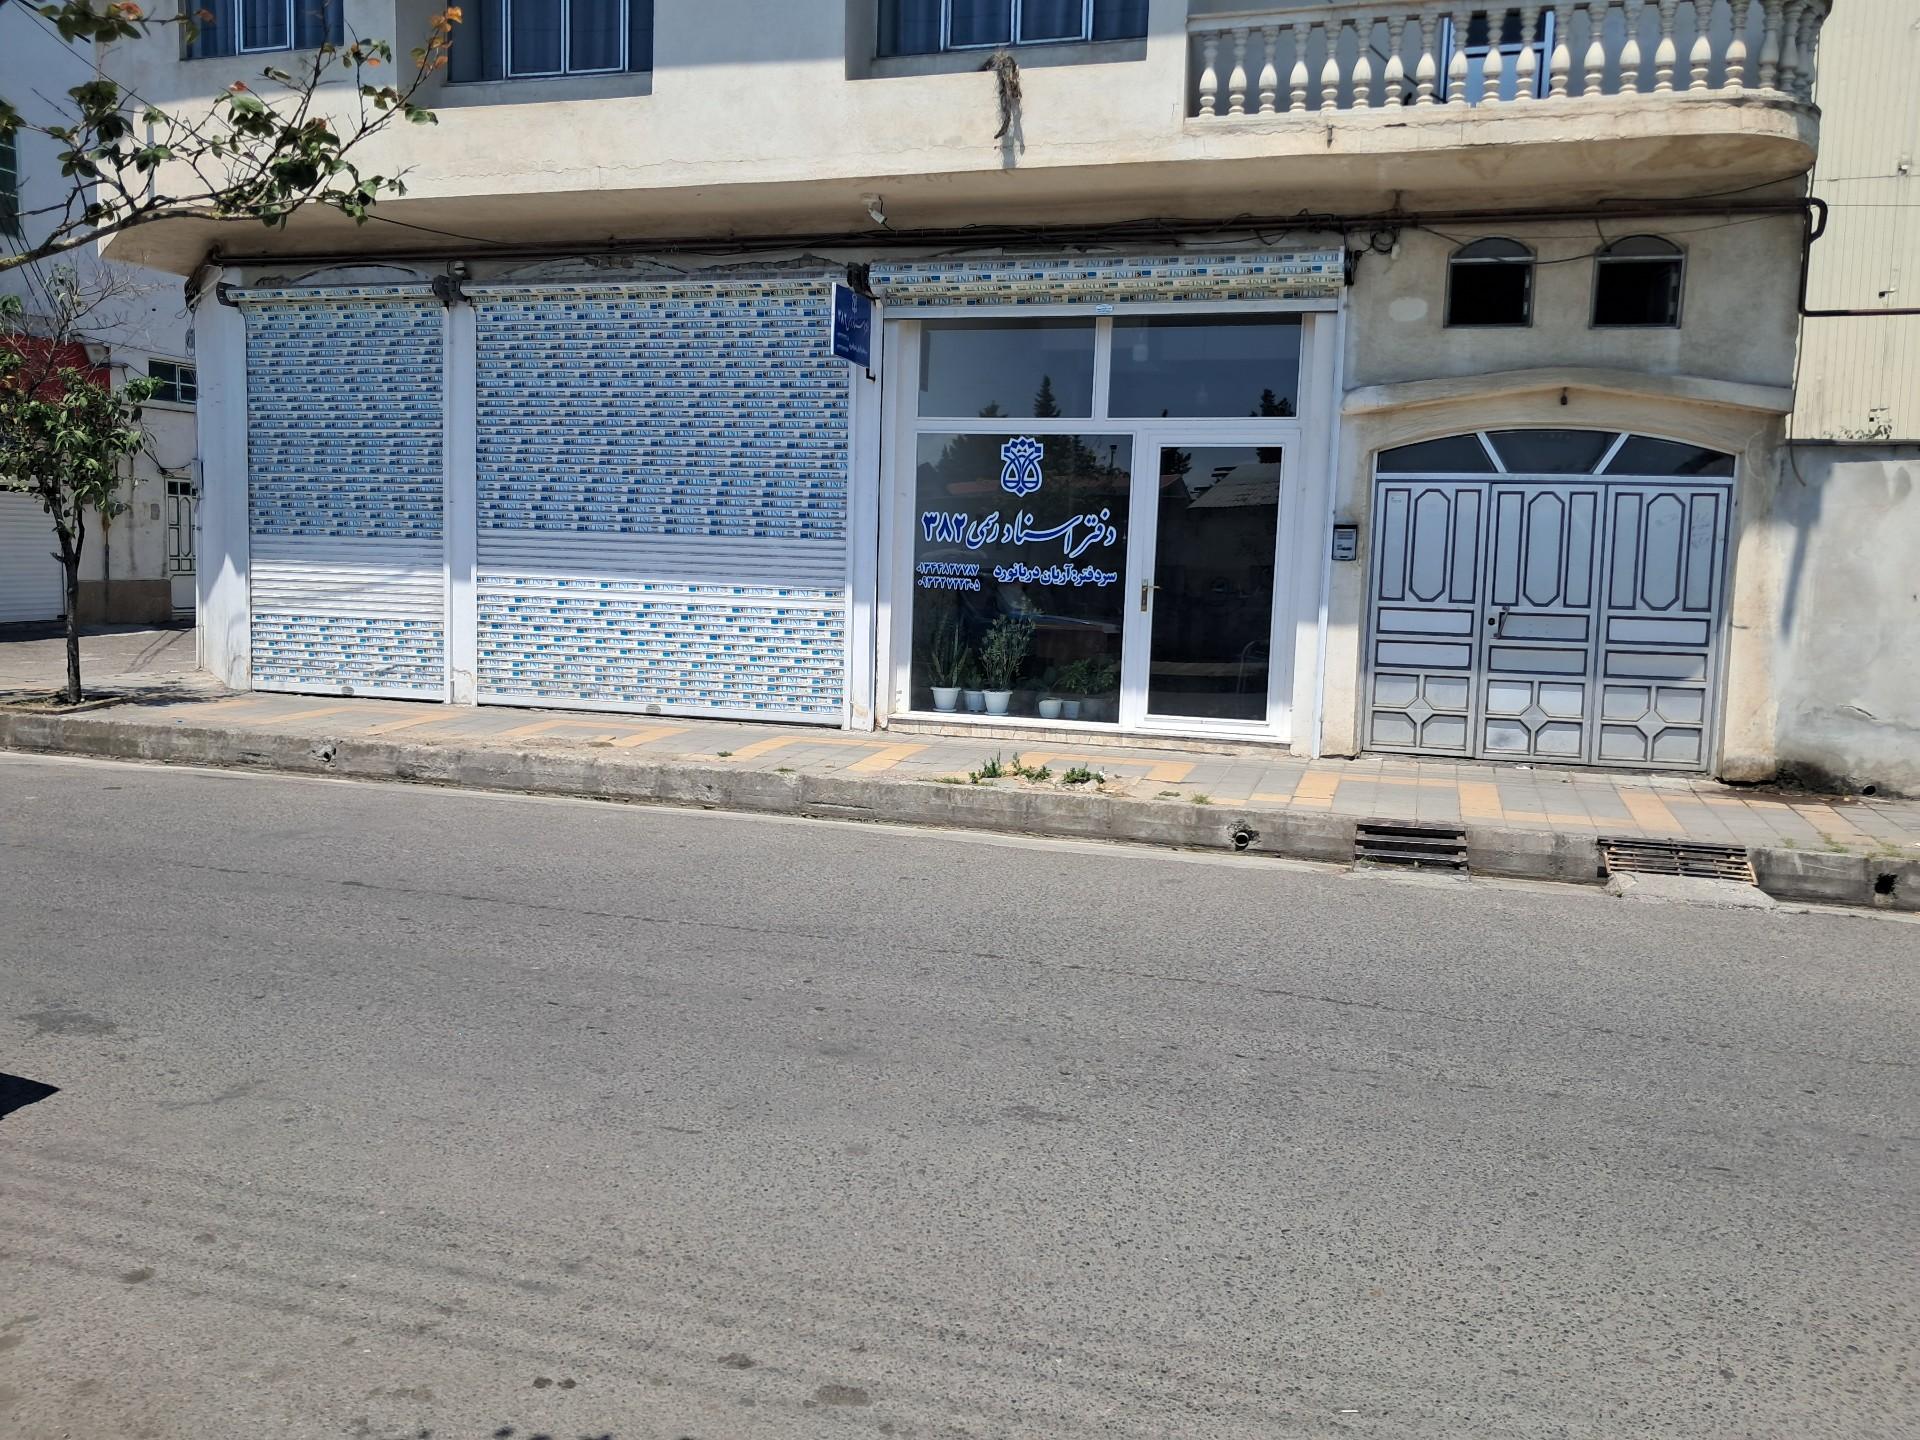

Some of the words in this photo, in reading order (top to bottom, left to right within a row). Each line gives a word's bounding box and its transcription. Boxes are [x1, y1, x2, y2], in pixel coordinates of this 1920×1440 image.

[921, 511, 967, 543] ۳۸۲
[965, 511, 999, 549] رسمی
[1001, 508, 1083, 554] اسناد
[1069, 508, 1117, 558] دفتر
[993, 562, 1041, 584] دریانورد
[1040, 563, 1072, 585] آریان
